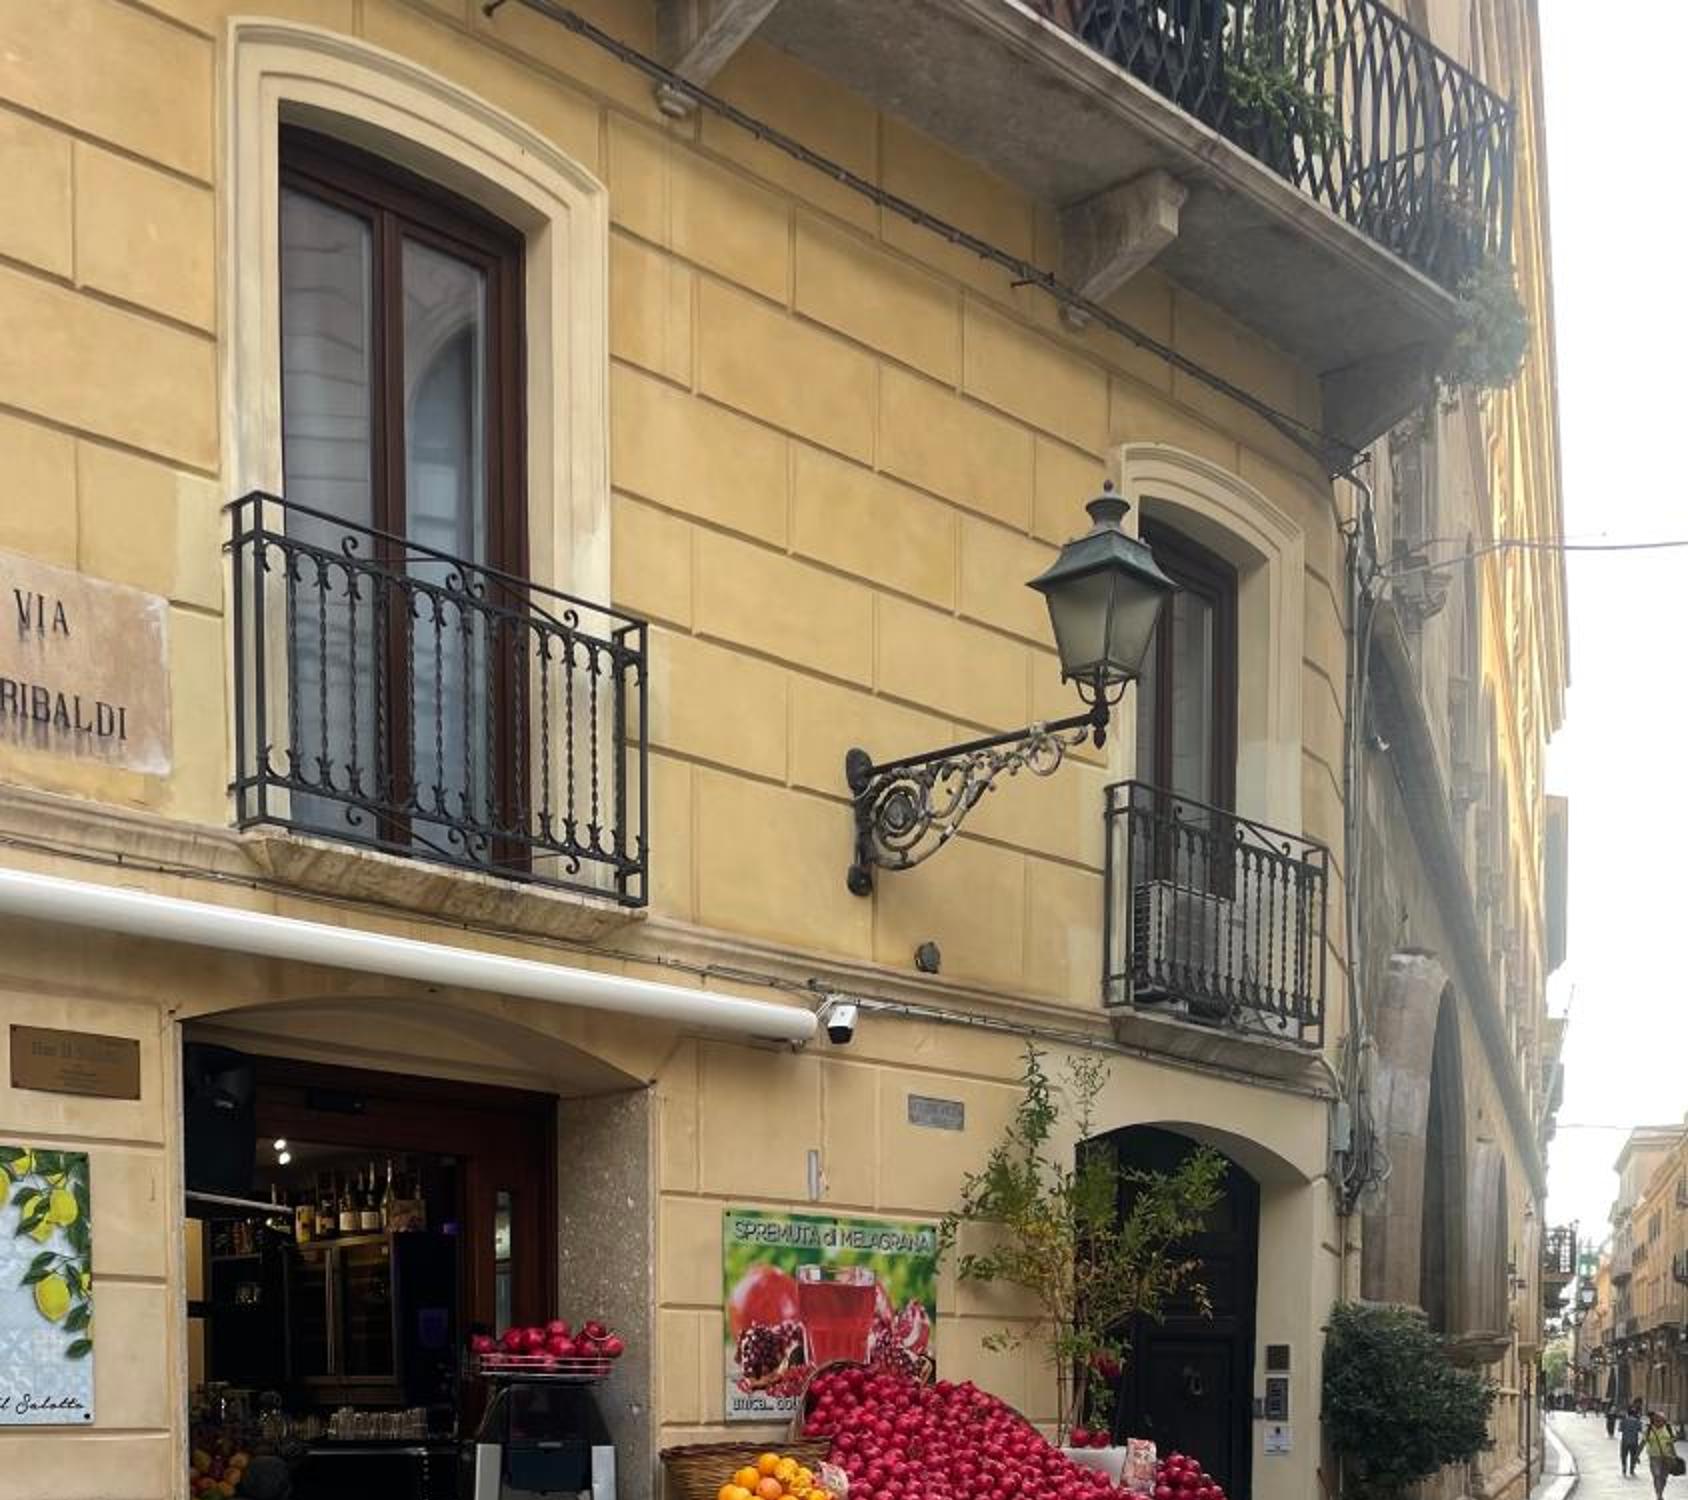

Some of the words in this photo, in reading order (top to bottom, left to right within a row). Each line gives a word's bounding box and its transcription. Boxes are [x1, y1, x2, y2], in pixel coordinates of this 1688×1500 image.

[13, 588, 70, 637] VIA
[735, 1220, 820, 1246] SPREMUTA
[841, 1230, 929, 1251] MELAGRANA
